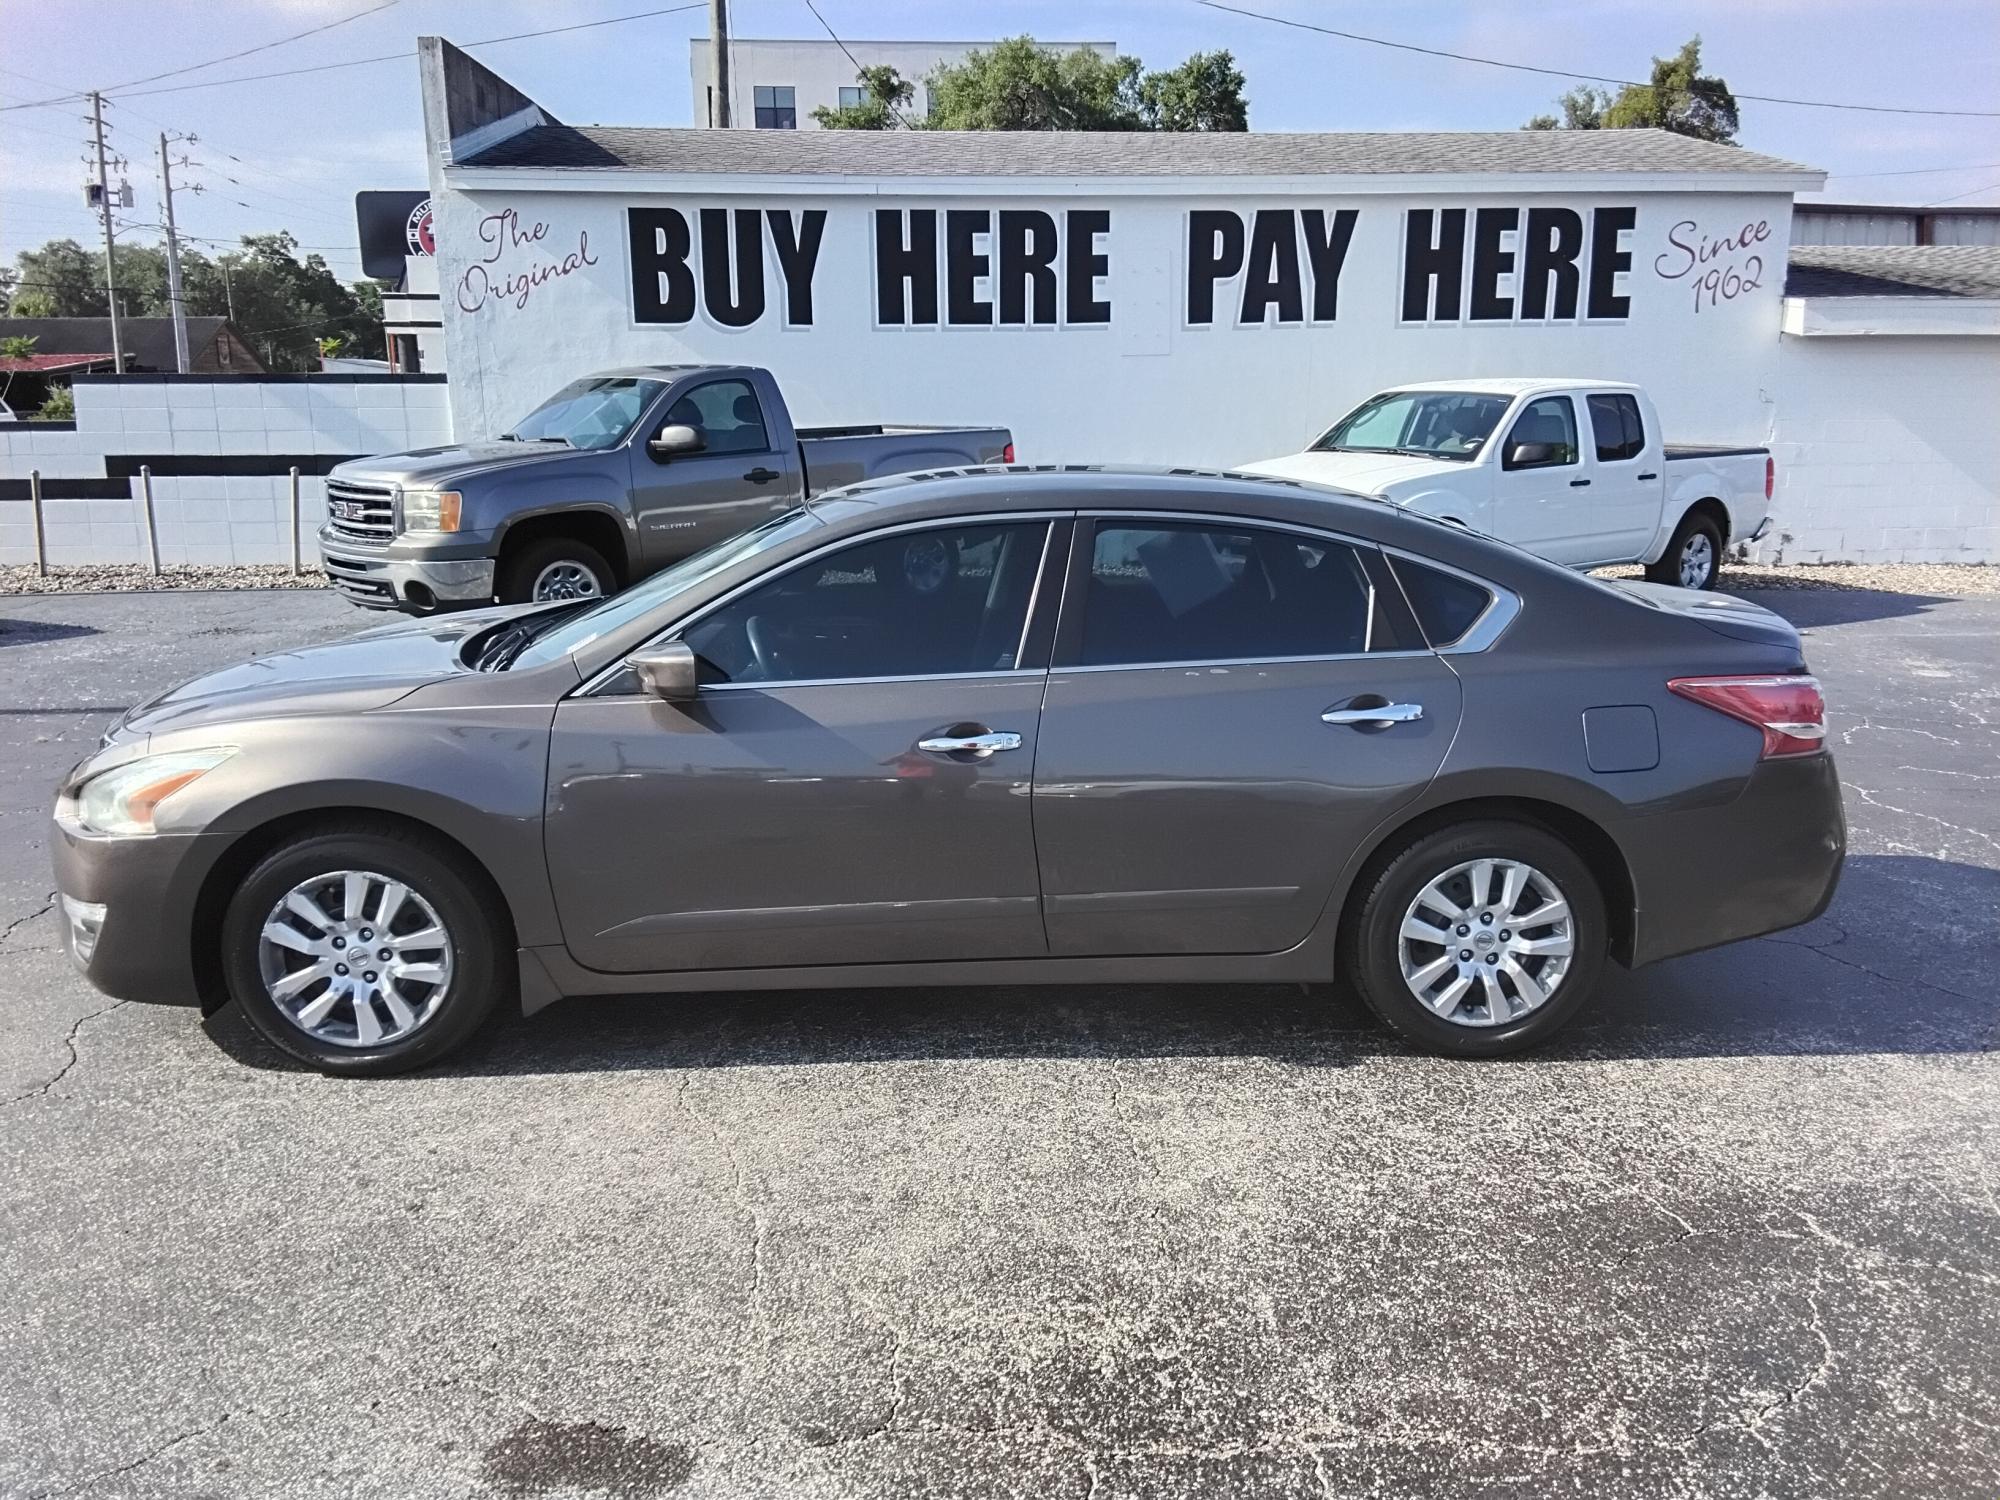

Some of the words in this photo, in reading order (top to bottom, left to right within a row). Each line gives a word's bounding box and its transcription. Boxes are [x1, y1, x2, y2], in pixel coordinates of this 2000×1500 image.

[479, 208, 549, 263] The
[1655, 220, 1771, 279] Since
[458, 231, 598, 313] Original
[628, 207, 827, 326] BUY
[876, 209, 1111, 324] HERE
[1188, 209, 1359, 324] PAY
[1402, 207, 1637, 321] HERE
[1692, 255, 1762, 314] 1962
[650, 521, 697, 531] SIERRA
